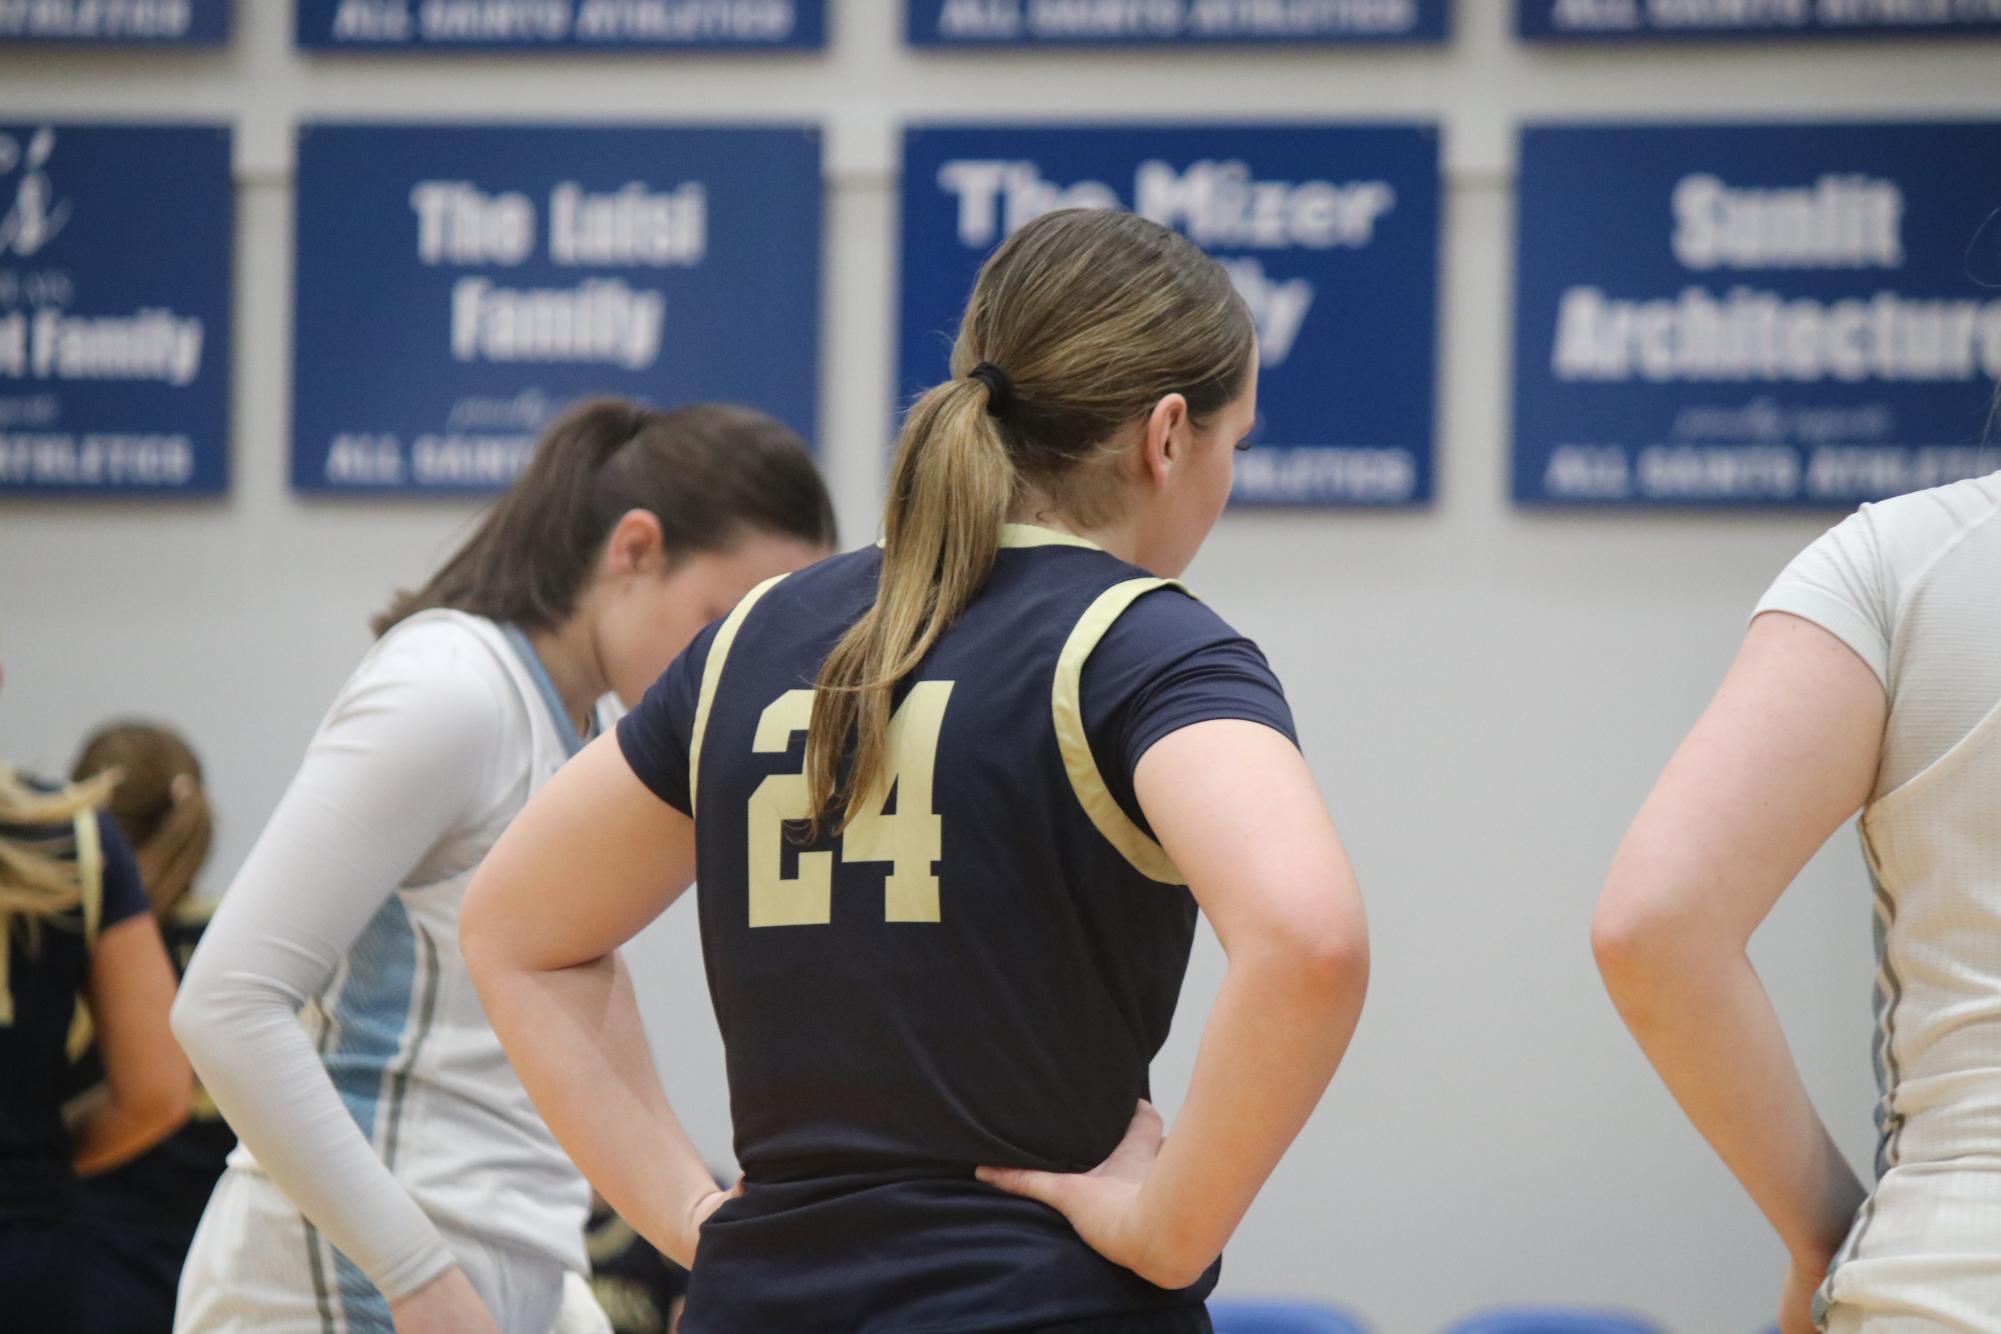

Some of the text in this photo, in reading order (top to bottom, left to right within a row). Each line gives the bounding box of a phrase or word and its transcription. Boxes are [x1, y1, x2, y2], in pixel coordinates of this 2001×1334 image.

[409, 180, 535, 266] The
[1134, 159, 1396, 247] Mizer
[1672, 174, 1902, 269] Sunlit
[31, 309, 204, 386] Family
[452, 277, 664, 369] Family
[748, 680, 955, 928] 24
